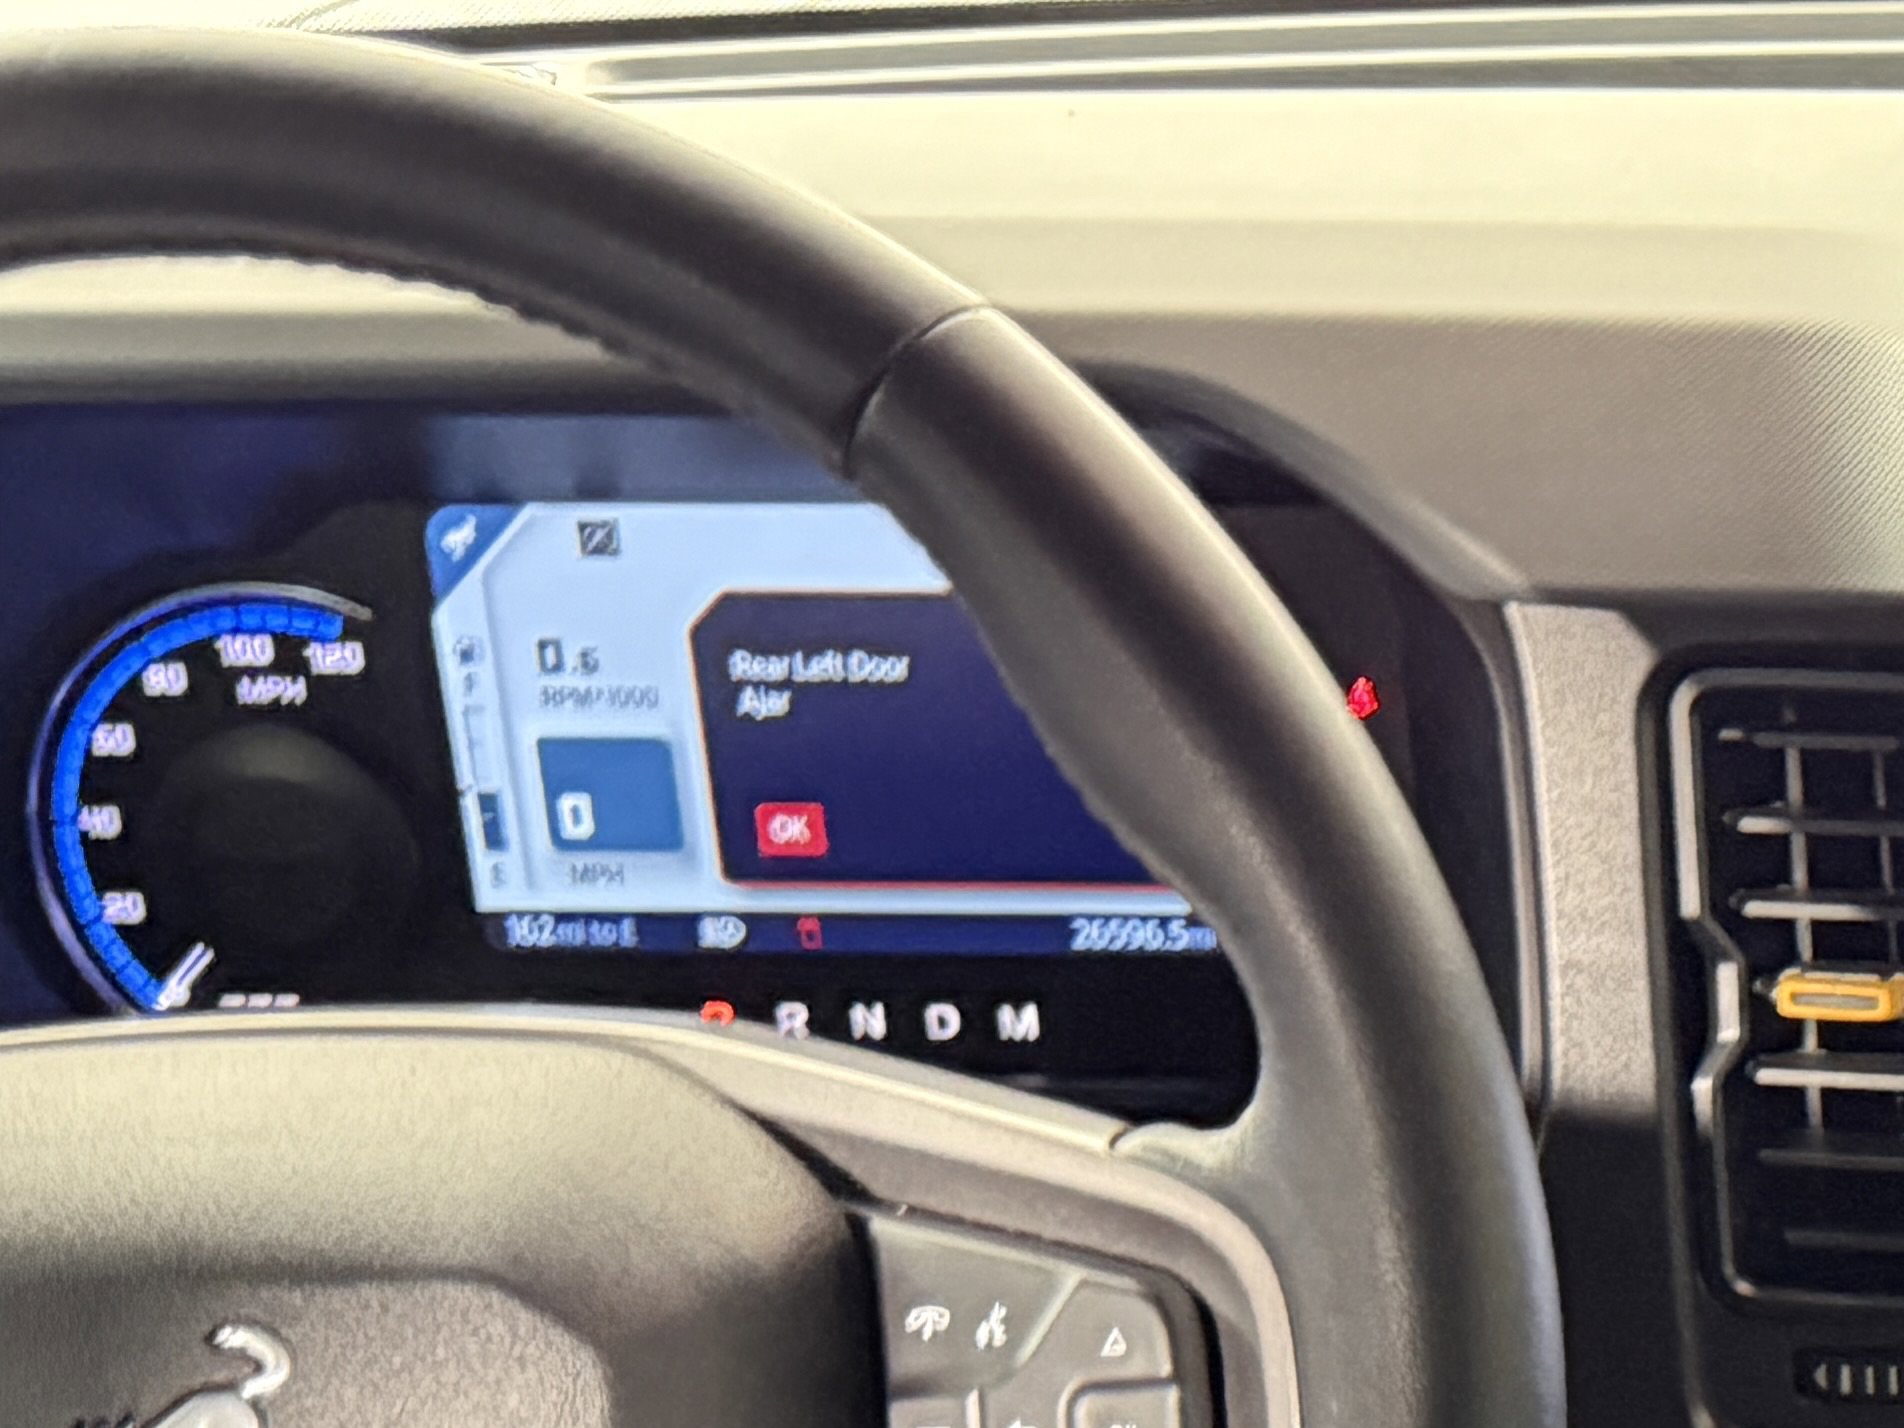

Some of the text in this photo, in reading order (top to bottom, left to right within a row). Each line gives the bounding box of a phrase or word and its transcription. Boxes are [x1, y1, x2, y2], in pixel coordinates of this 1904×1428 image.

[217, 633, 275, 667] 100
[306, 641, 366, 675] 120
[729, 649, 909, 682] Rear Left Door
[735, 686, 792, 720] Ajar
[768, 814, 812, 845] OK
[775, 1003, 809, 1038] R
[849, 1003, 887, 1041] N
[924, 1004, 961, 1041] D
[996, 1003, 1040, 1042] M
